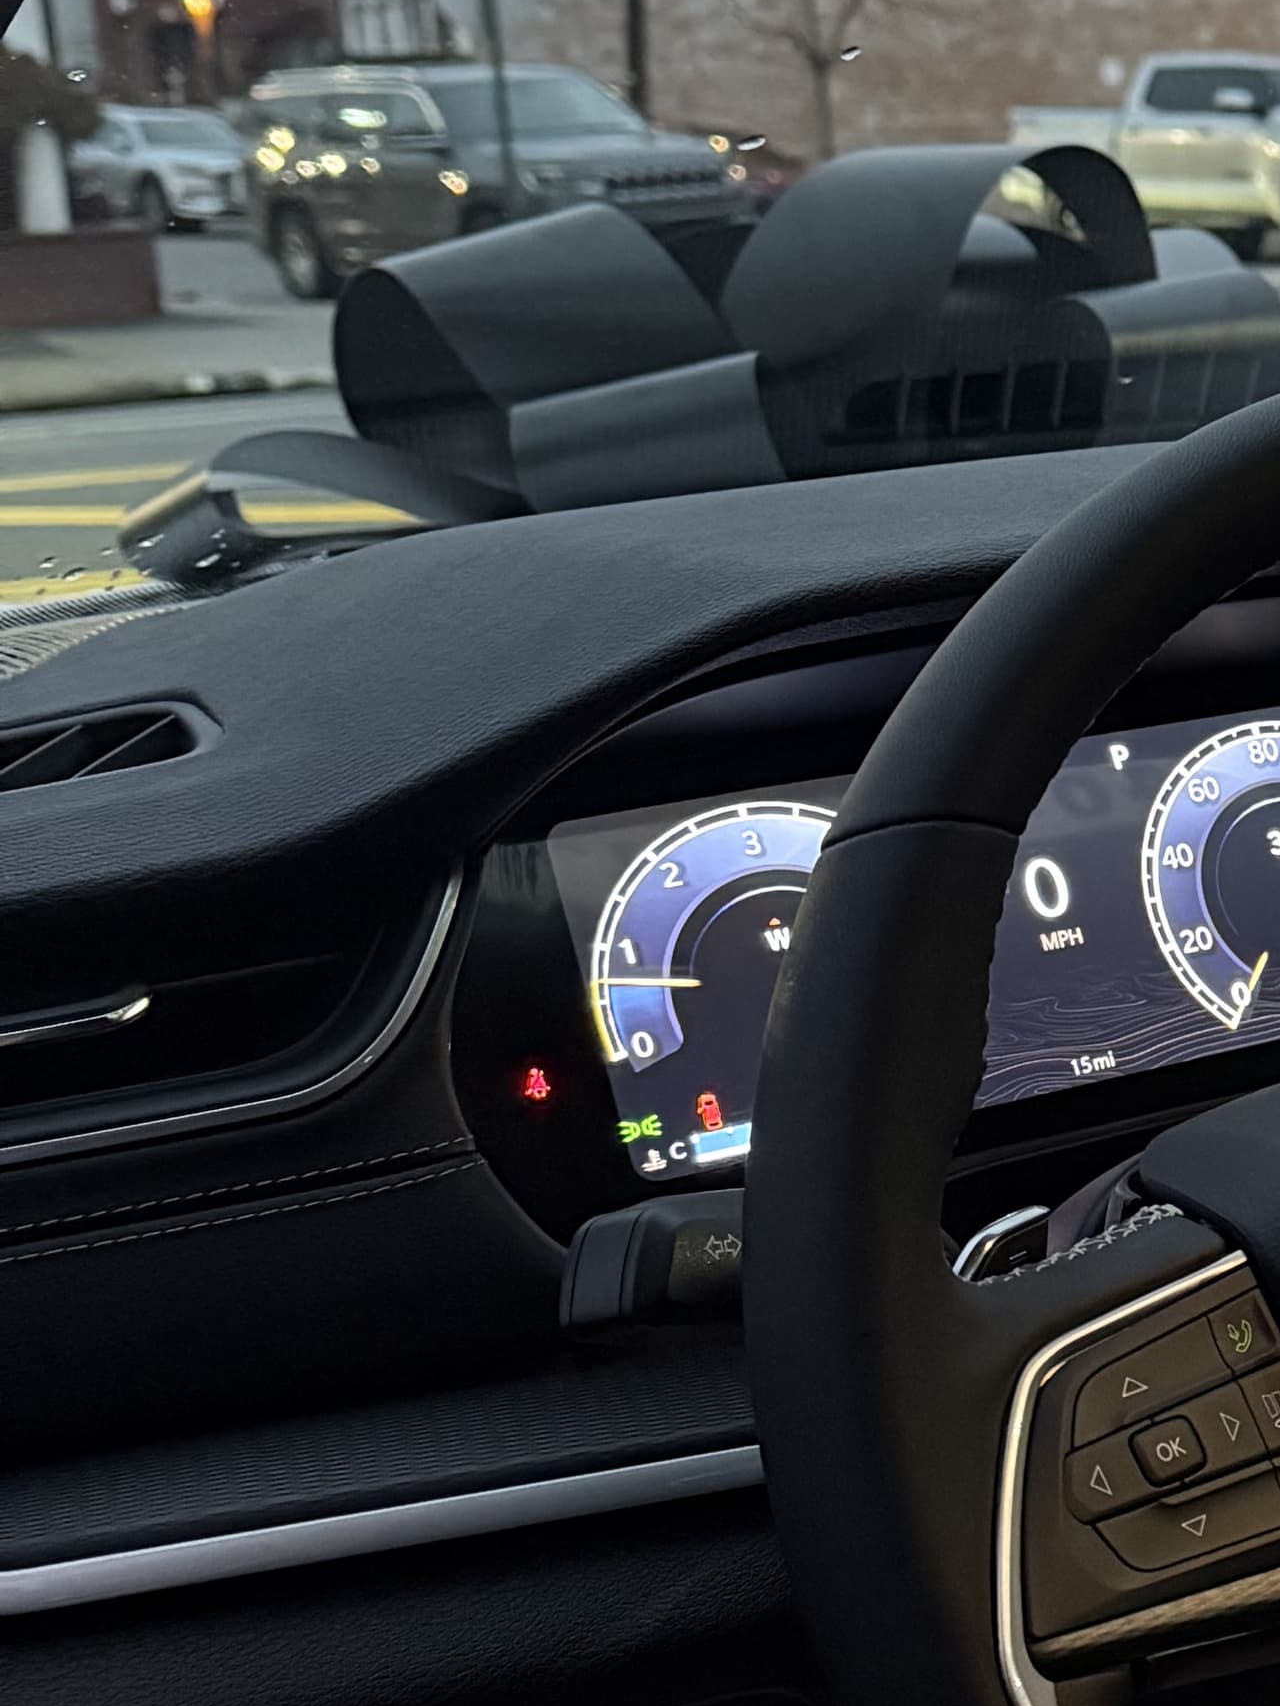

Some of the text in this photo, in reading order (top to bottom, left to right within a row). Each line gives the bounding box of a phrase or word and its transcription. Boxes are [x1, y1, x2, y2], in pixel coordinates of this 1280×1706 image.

[1108, 744, 1129, 770] P
[1247, 738, 1279, 764] 80
[1187, 776, 1219, 803] 60
[741, 830, 763, 855] 3
[1162, 842, 1193, 869] 40
[660, 861, 685, 888] 2
[1024, 856, 1070, 919] 0
[618, 937, 638, 964] 1
[1039, 926, 1084, 952] MPH
[1179, 925, 1213, 955] 20
[1231, 979, 1251, 1008] 0
[631, 1031, 655, 1058] 0
[1069, 1048, 1117, 1078] 15mi
[669, 1140, 687, 1160] C
[1156, 1437, 1187, 1464] OK
